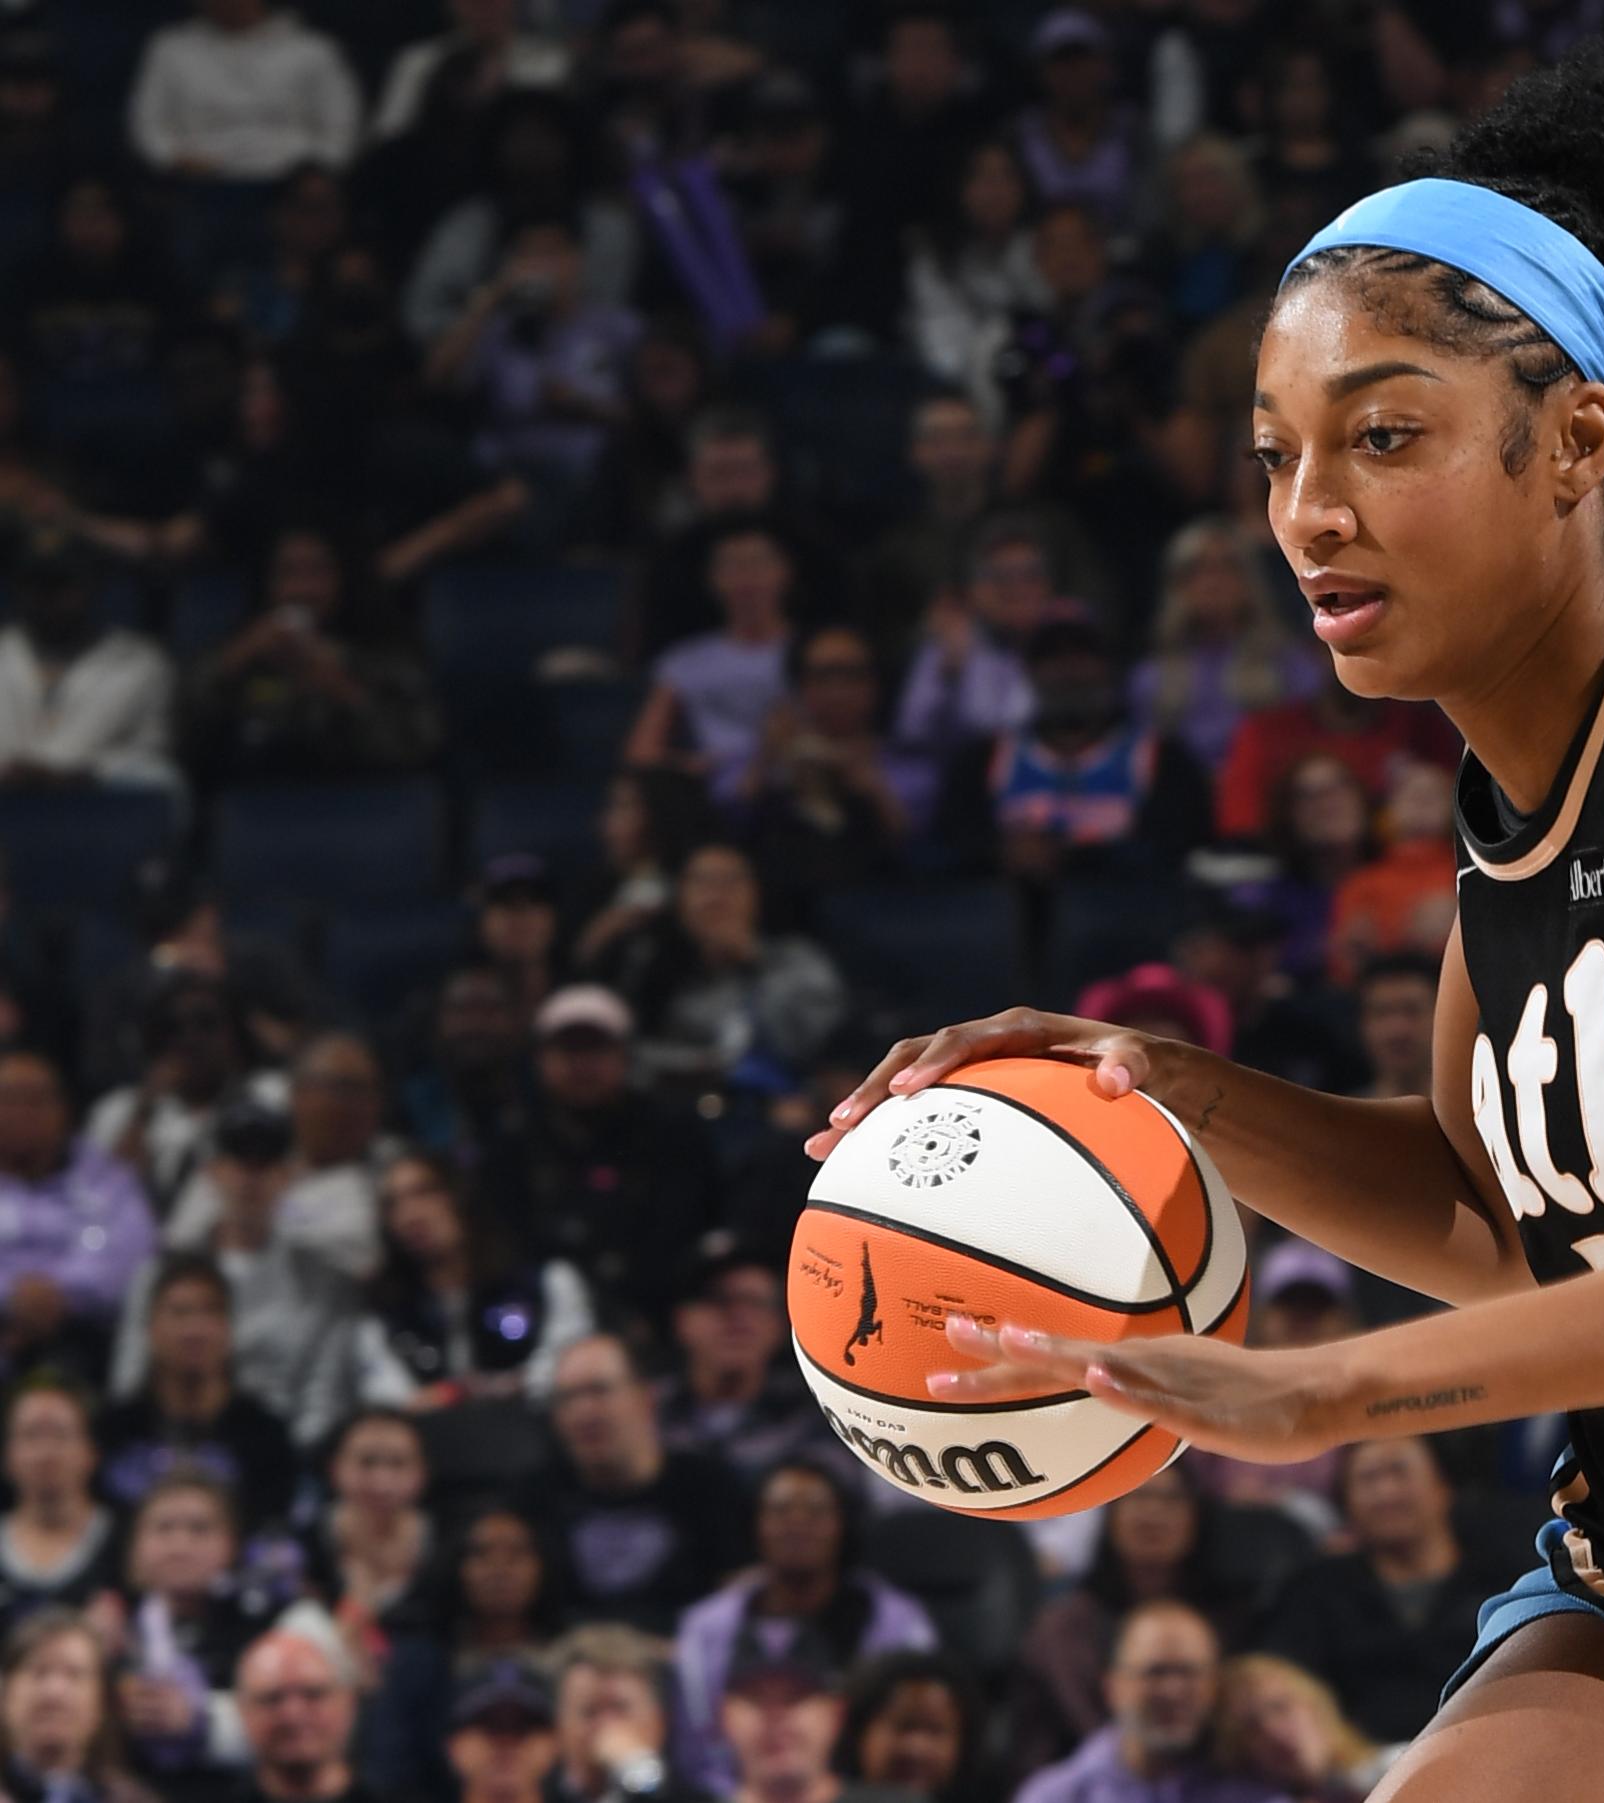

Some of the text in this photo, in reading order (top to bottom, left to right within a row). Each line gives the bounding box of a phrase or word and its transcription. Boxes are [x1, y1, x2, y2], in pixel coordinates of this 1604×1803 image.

[901, 1298, 942, 1316] BALL
[910, 1314, 946, 1331] CIAL
[821, 1402, 1048, 1494] Wilso
